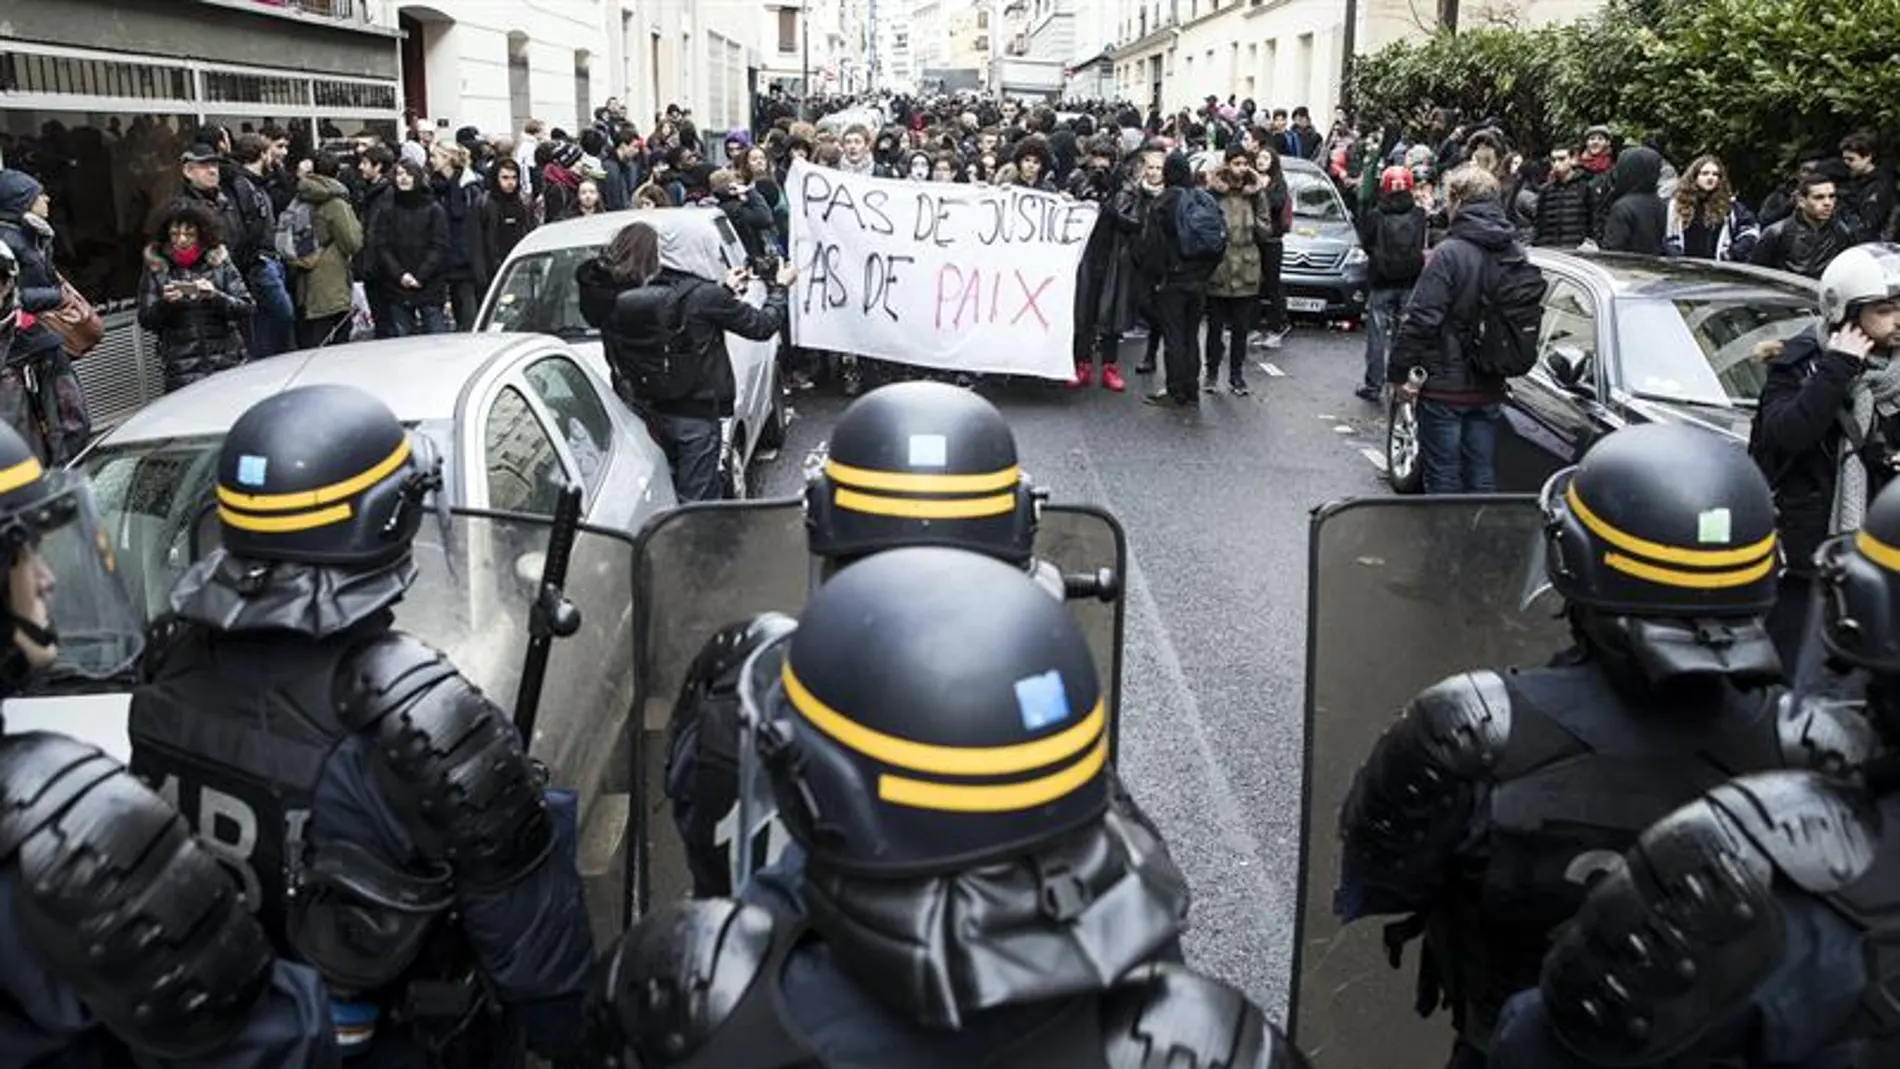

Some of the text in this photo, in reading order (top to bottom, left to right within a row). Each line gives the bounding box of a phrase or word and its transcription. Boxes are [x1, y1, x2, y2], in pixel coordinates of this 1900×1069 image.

[802, 172, 1098, 247] PAS DE JUSTICE
[863, 252, 914, 321] DE
[935, 262, 1056, 331] PAIX
